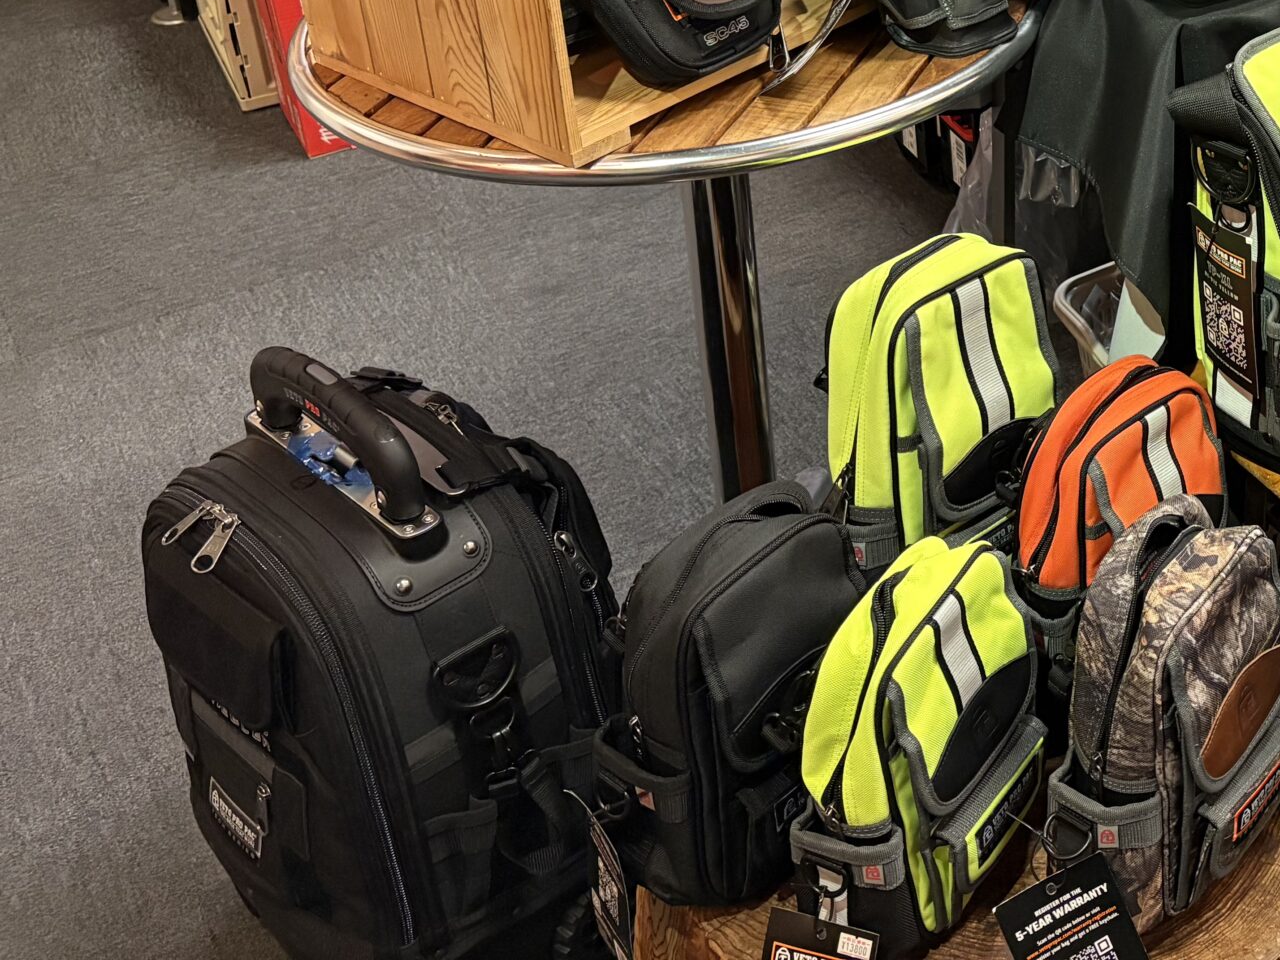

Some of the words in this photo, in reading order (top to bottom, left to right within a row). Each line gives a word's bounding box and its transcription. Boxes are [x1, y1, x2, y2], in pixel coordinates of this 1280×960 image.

[703, 15, 749, 46] SC45
[304, 398, 320, 417] PRO
[1014, 915, 1054, 942] 5-YEAR
[1052, 882, 1109, 920] WARRANTY
[1034, 899, 1060, 917] REGISTER
[1060, 893, 1072, 903] FOR
[1071, 887, 1083, 897] THE
[1036, 938, 1048, 947] Scan
[1047, 932, 1055, 941] the
[1055, 928, 1062, 937] QR
[1061, 922, 1073, 933] code
[1072, 915, 1086, 927] below
[1091, 906, 1101, 916] visit
[841, 940, 868, 956] ¥13800
